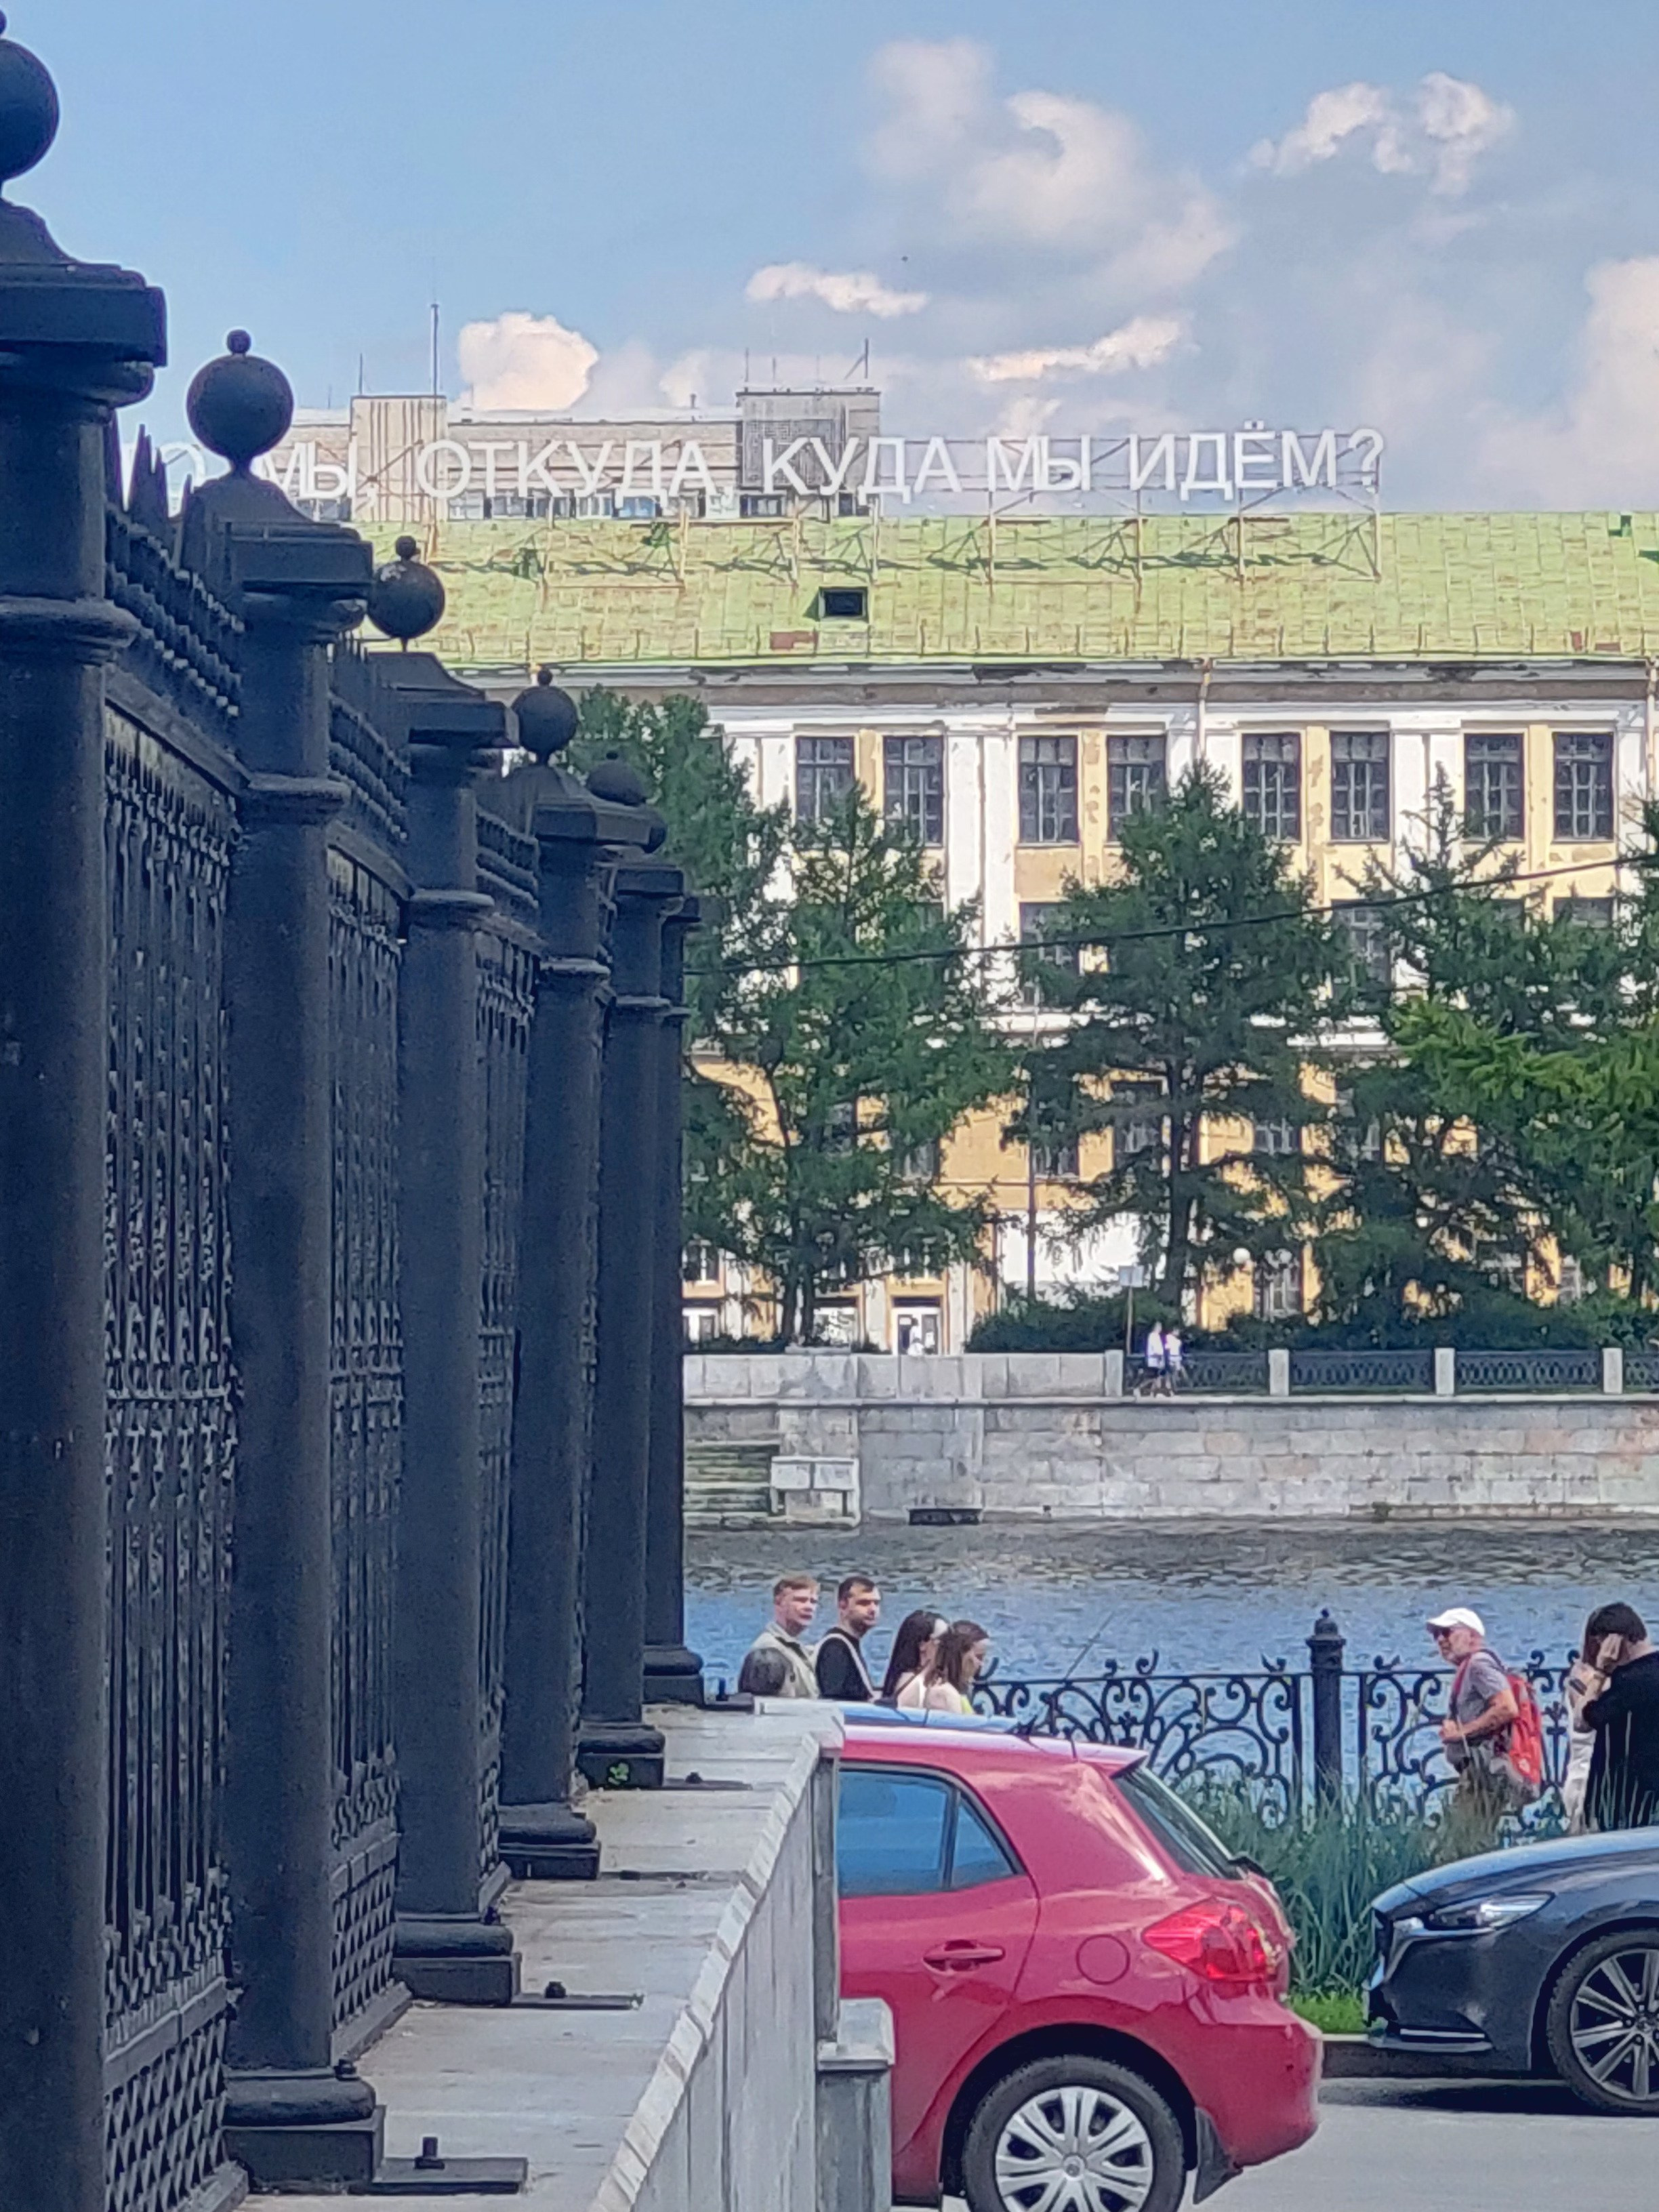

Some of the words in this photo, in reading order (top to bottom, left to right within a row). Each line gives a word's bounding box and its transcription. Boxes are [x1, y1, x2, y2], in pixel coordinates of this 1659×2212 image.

[763, 437, 963, 506] КУДА
[987, 435, 1091, 492] МЫ
[1129, 420, 1384, 500] ИДЁМ?
